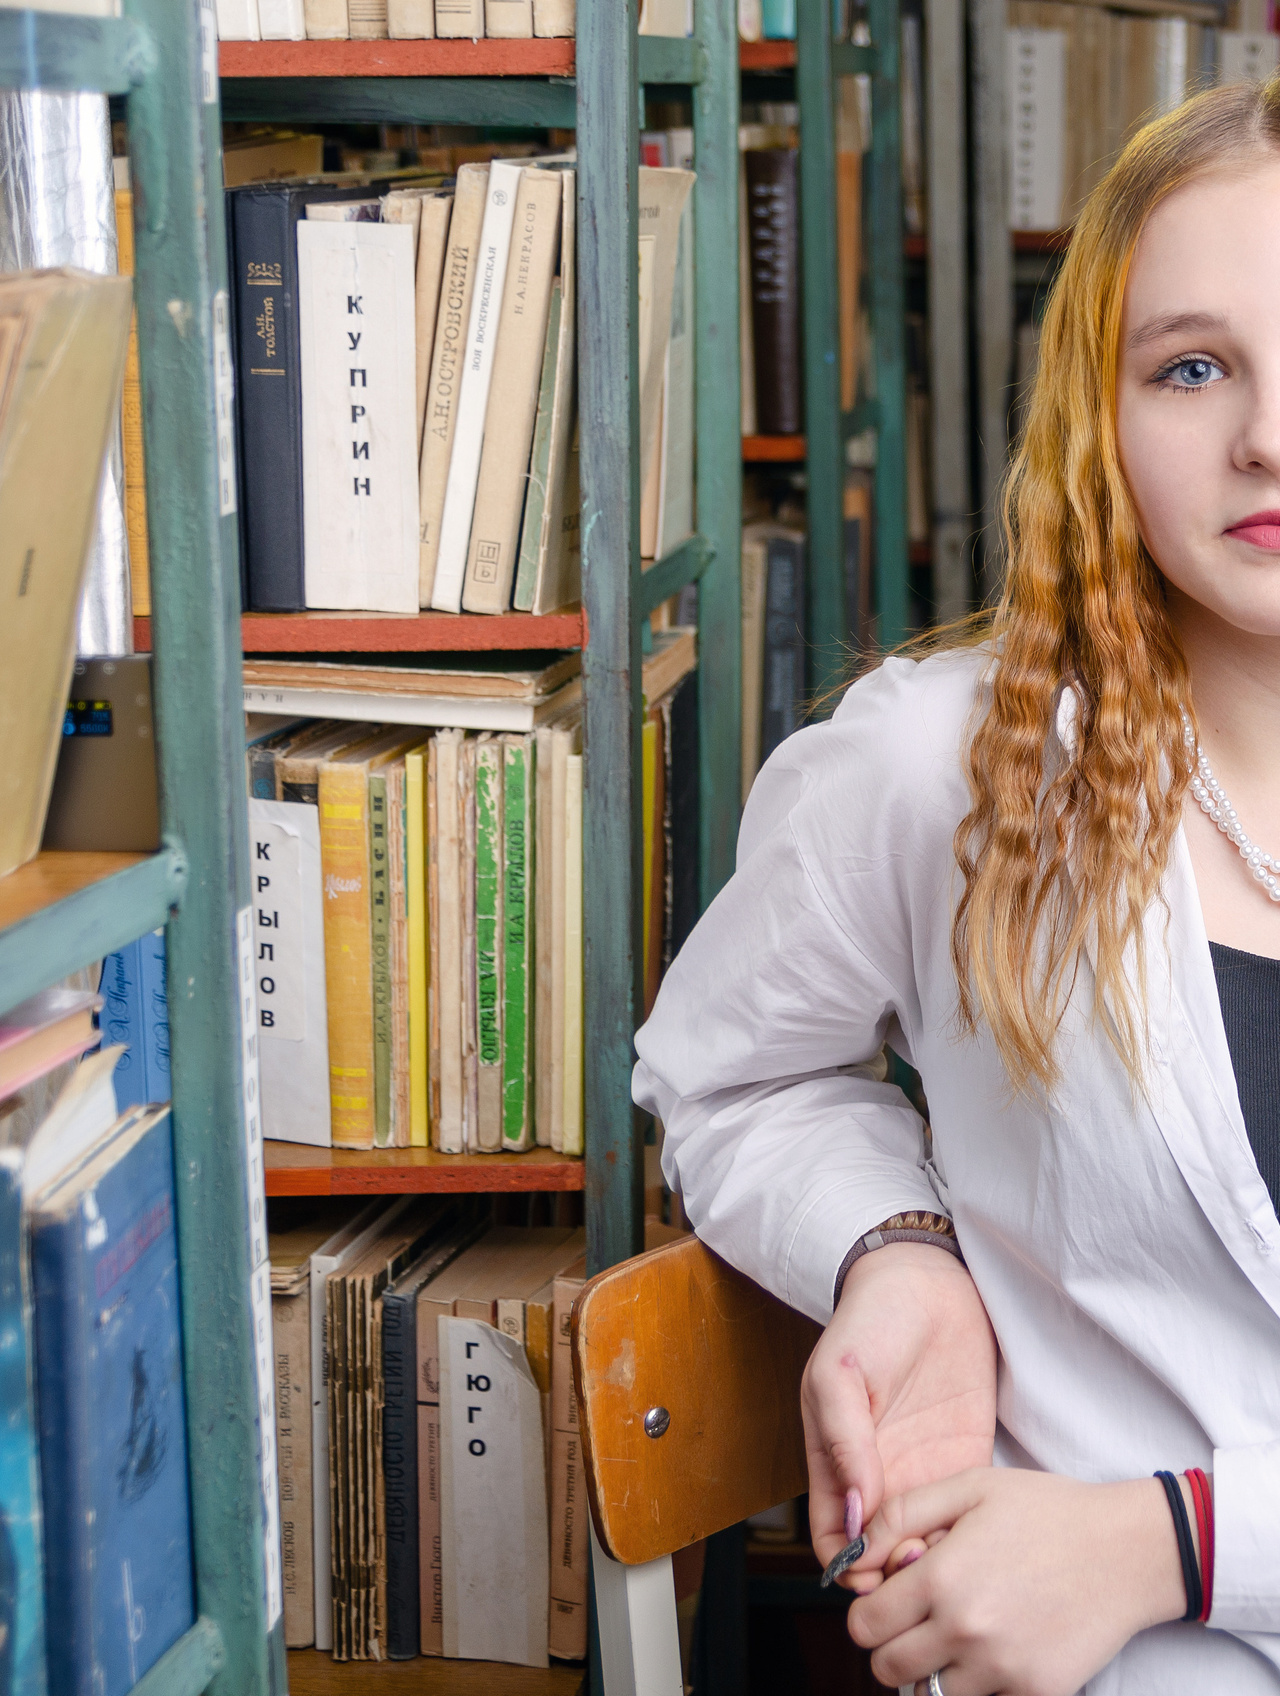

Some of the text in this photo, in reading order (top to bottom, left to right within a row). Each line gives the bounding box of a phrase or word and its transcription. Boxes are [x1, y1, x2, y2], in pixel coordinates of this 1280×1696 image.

[263, 296, 276, 358] ТОЛСТОЙ
[472, 245, 498, 372] ЗОЯ ВОСКРЕСЕНСКАЯ
[346, 294, 372, 497] КУПРИН
[373, 796, 386, 906] БАСНИ
[508, 819, 525, 904] КРЫЛОВ
[256, 842, 280, 1028] КРЫЛОВ
[481, 991, 498, 1064] КРЫЛО
[277, 1353, 291, 1420] РАССКАЗЫ
[465, 1341, 491, 1457] ГЮГО
[280, 1445, 294, 1501] ПОВСТИ
[562, 1440, 578, 1569] ДЕВЯНОСТО ТРЕТИЙ ГОД
